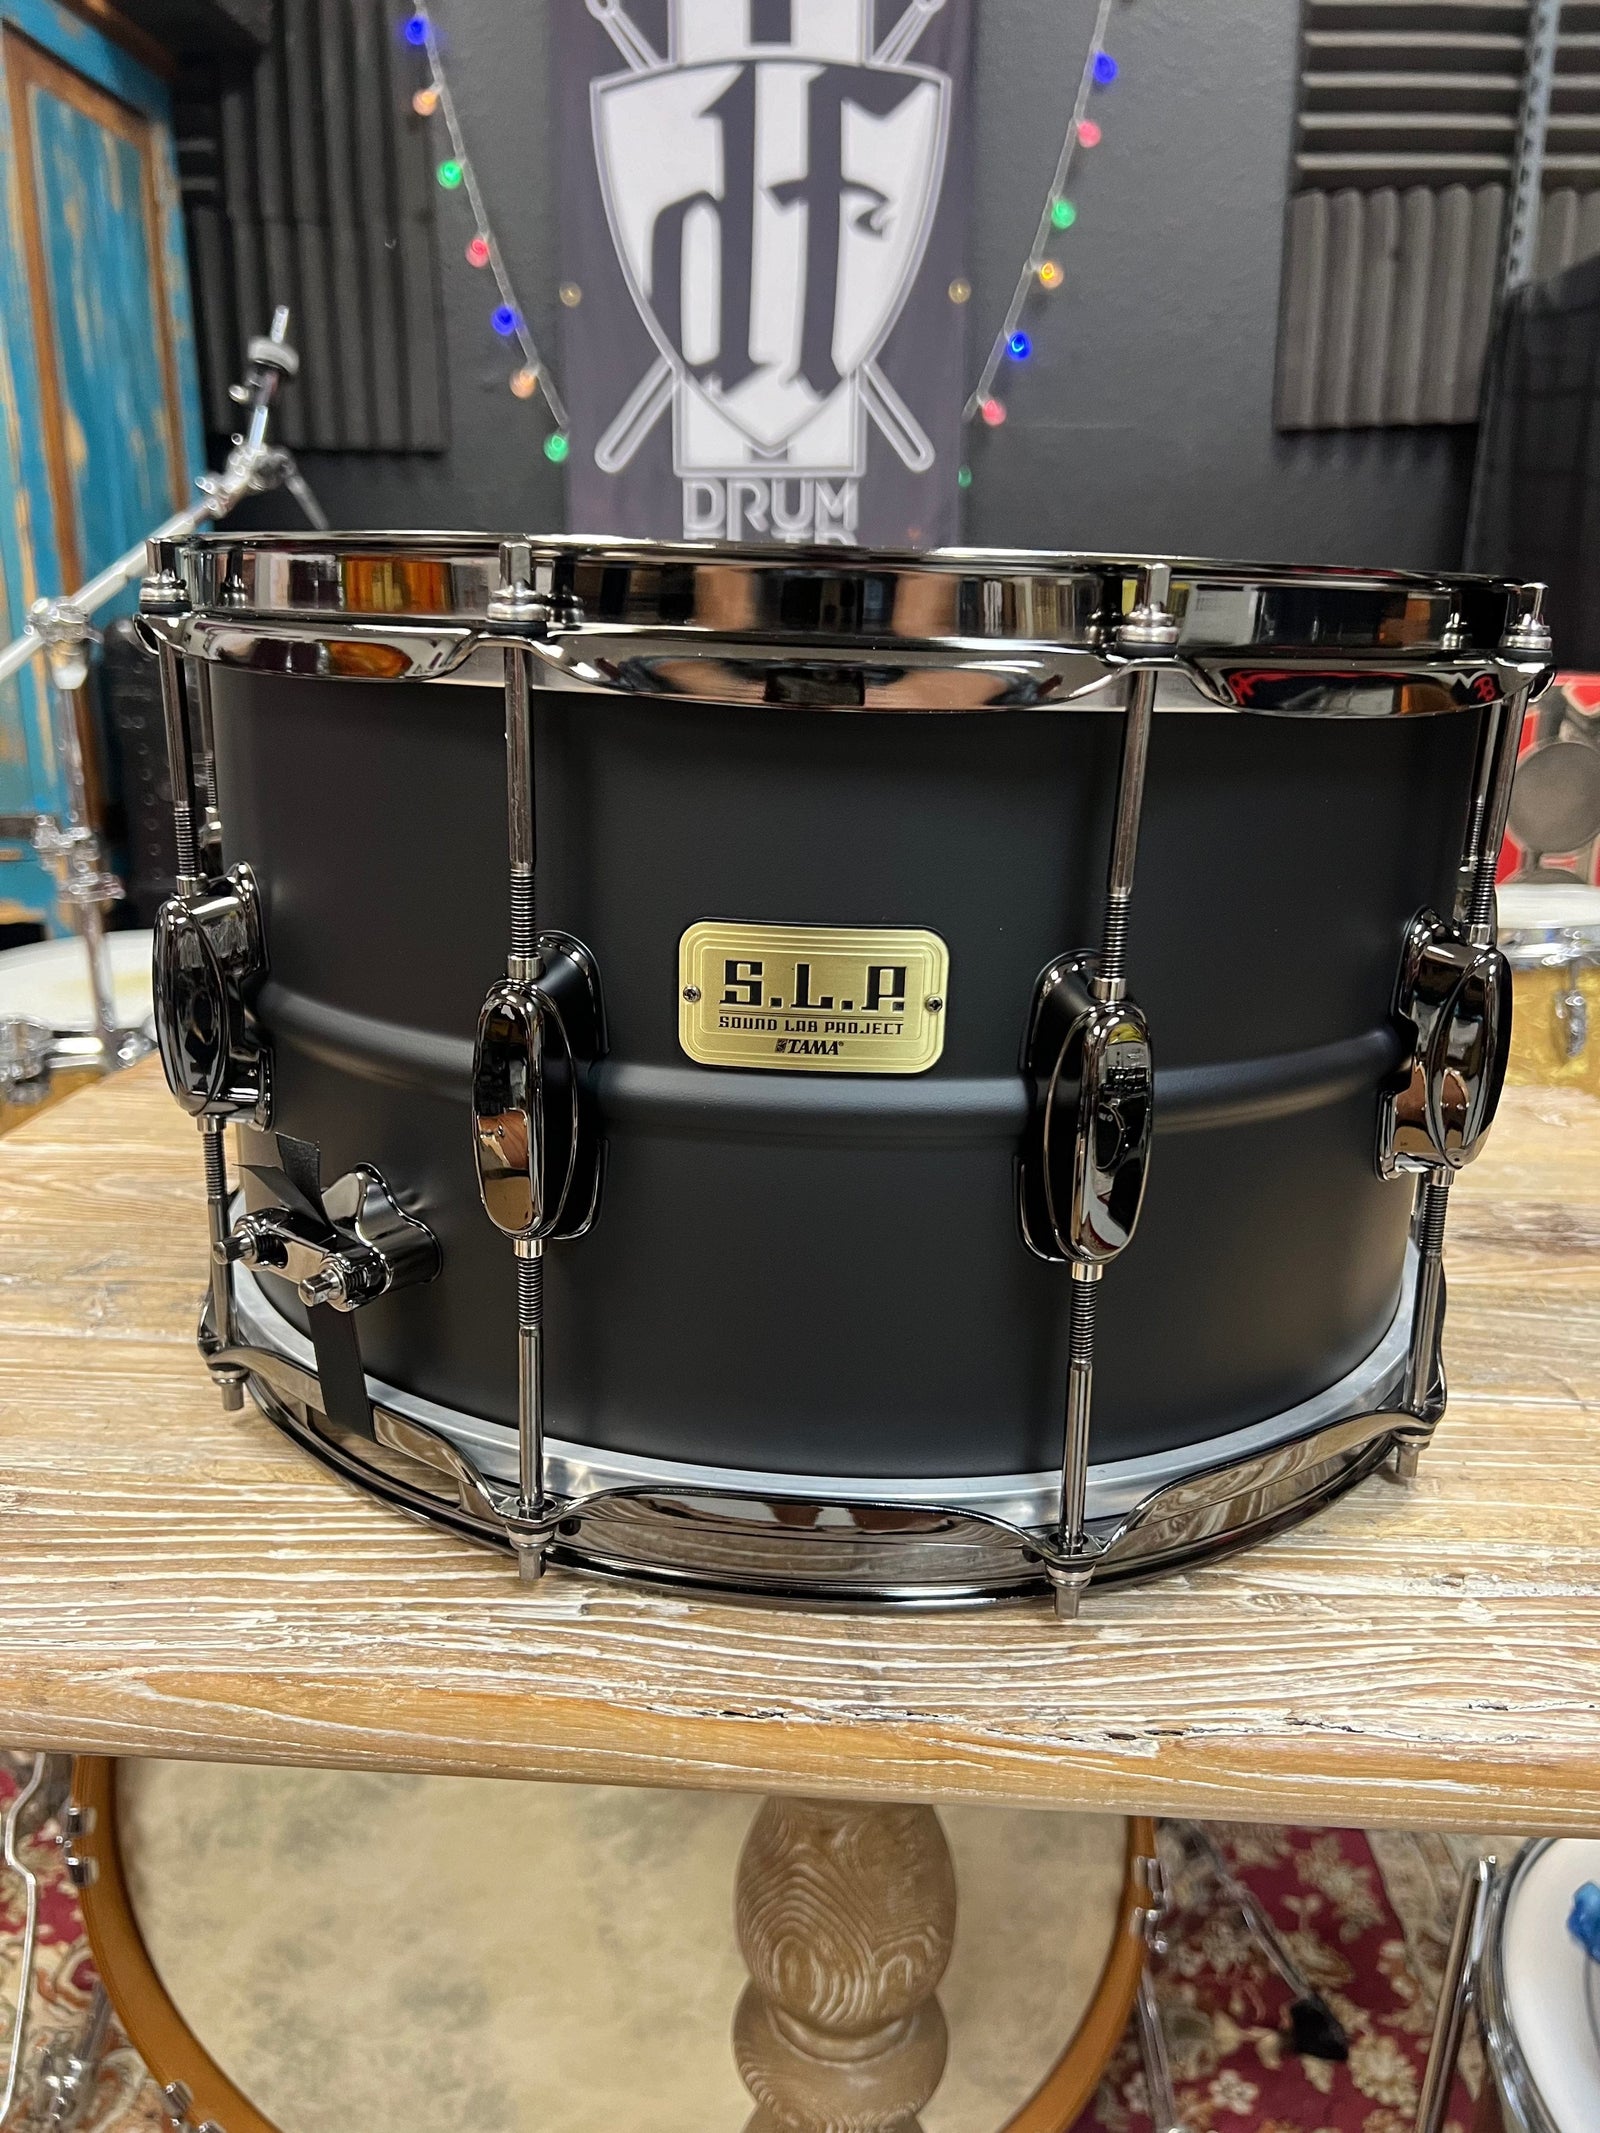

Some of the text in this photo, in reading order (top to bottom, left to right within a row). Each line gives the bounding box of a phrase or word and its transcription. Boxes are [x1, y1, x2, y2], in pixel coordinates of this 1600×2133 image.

[683, 478, 859, 532] DRUM
[718, 1015, 904, 1035] SOUND LAB PROJECT
